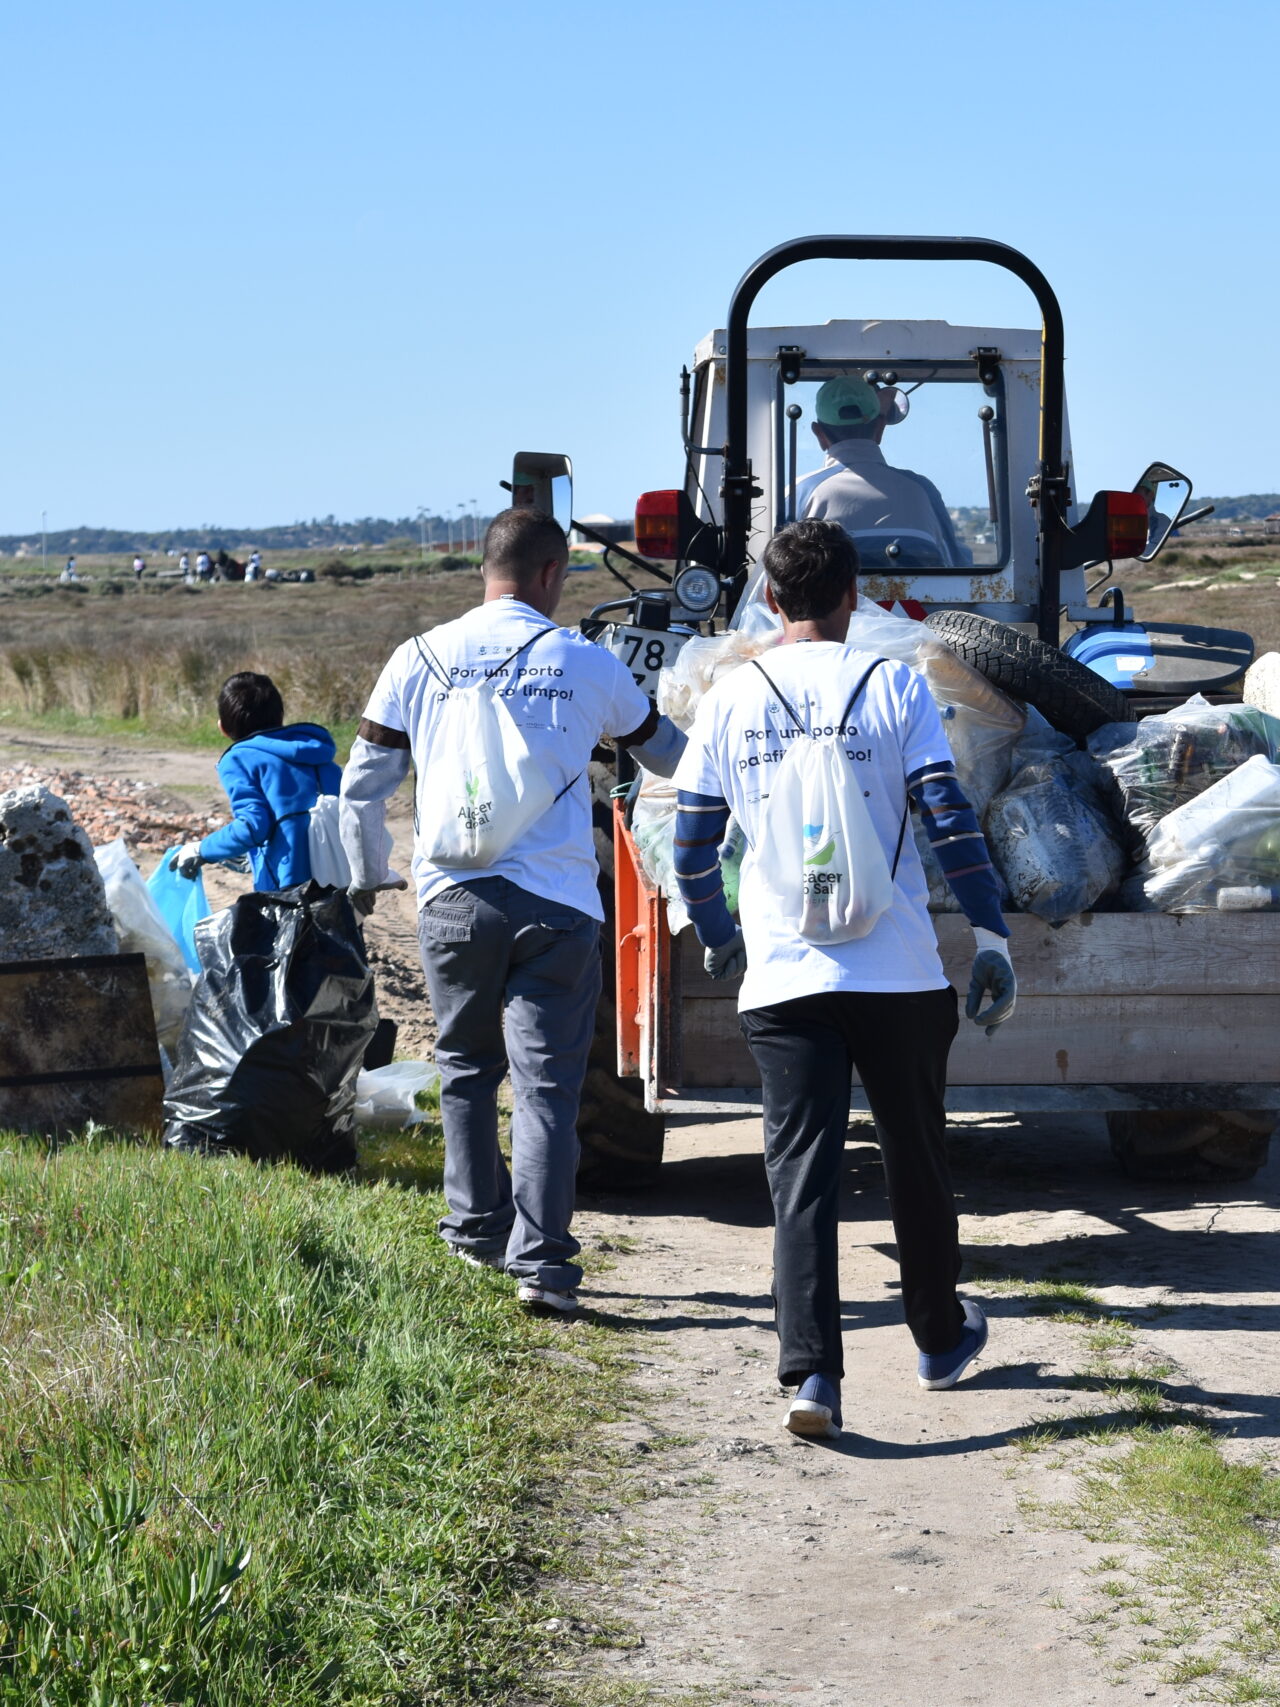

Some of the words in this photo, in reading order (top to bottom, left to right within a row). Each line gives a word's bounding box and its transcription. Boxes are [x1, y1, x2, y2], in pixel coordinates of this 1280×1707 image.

[624, 635, 665, 671] 78
[450, 667, 477, 679] Por
[484, 667, 509, 678] um
[517, 665, 564, 679] porto
[523, 685, 573, 701] limpo!
[744, 729, 772, 742] Por
[779, 728, 805, 739] um
[803, 870, 843, 884] cácer
[813, 883, 834, 895] Sal
